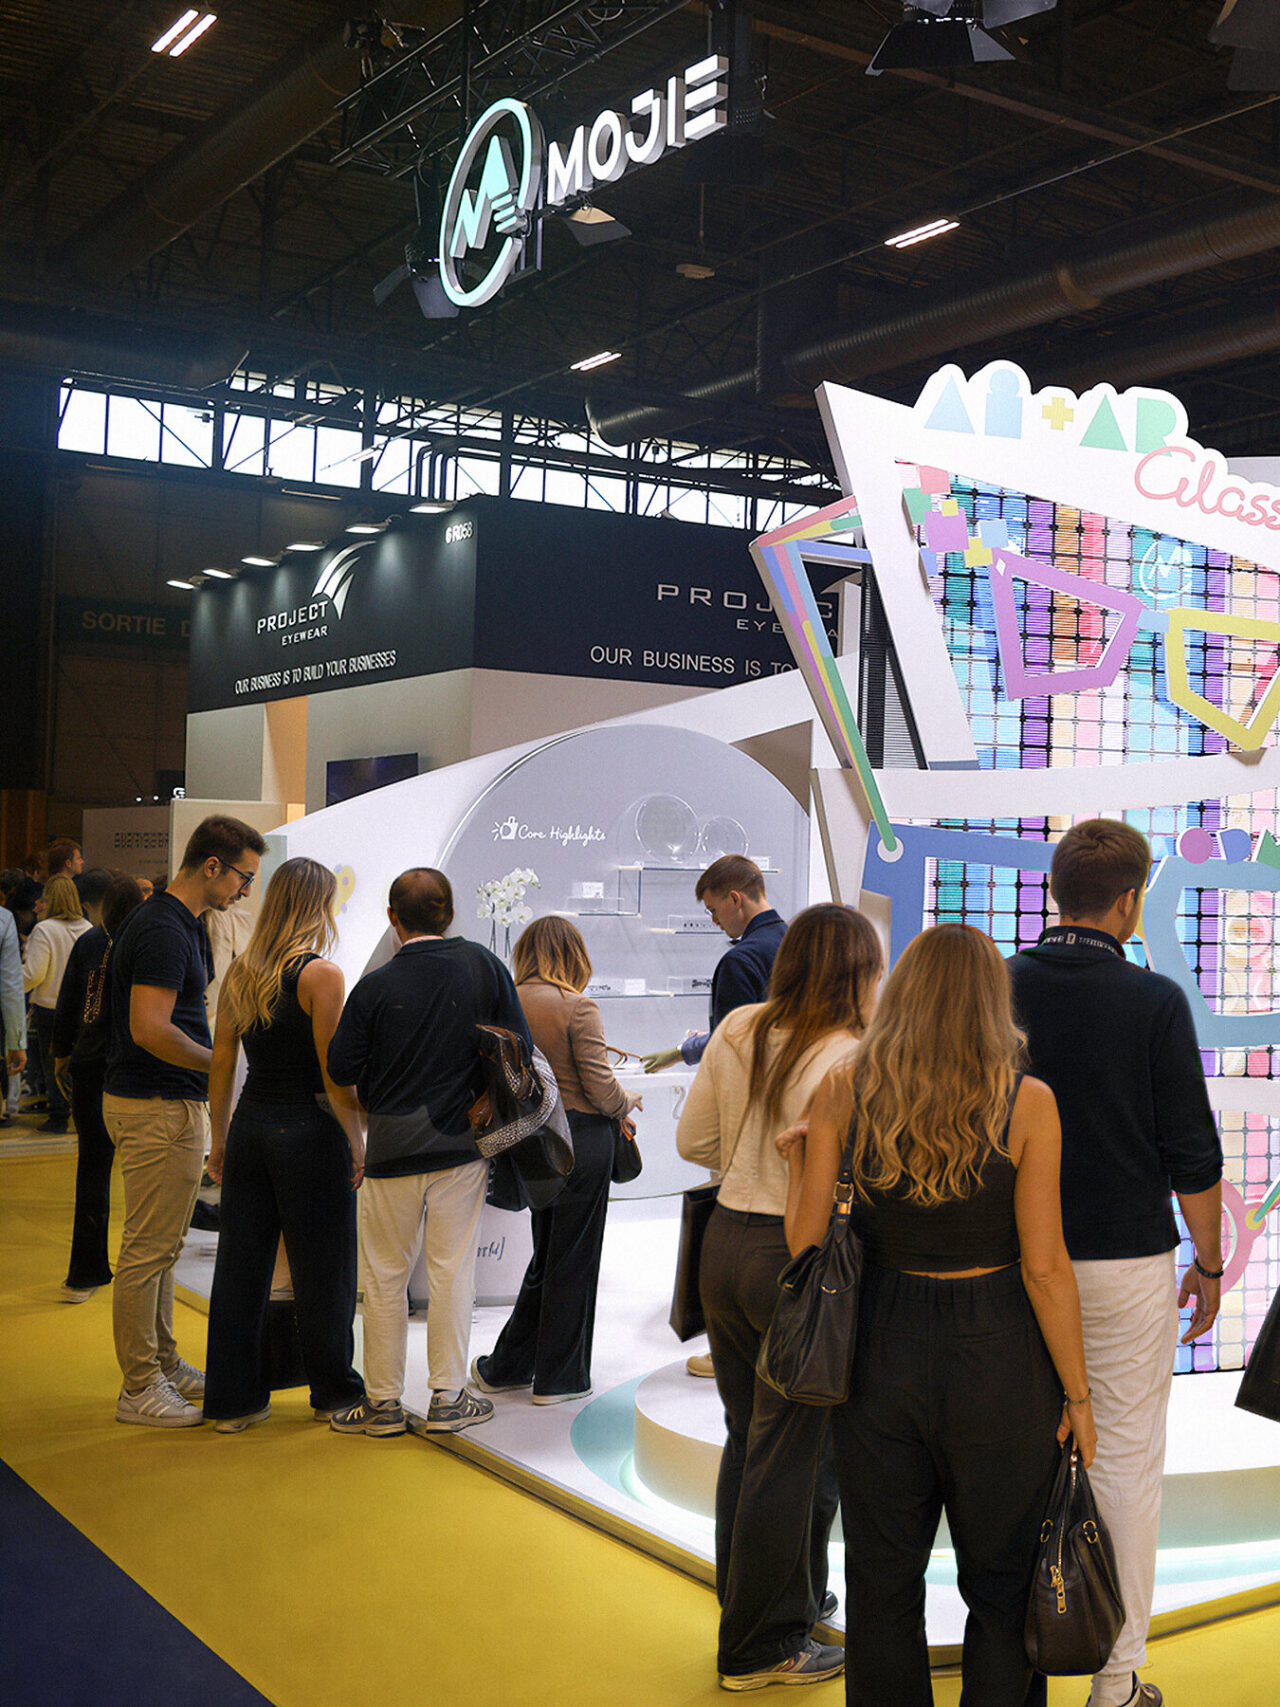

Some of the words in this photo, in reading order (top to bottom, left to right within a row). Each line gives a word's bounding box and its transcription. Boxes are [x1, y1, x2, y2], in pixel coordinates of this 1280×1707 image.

[547, 54, 730, 207] MOJIE
[256, 600, 329, 635] PROJECT
[657, 583, 833, 619] PROJC
[81, 610, 167, 636] SORTIE
[281, 625, 329, 647] EYEWEAR
[234, 676, 249, 694] OUR
[250, 672, 282, 692] BUSINESS
[282, 669, 290, 686] IS
[291, 668, 302, 684] TO
[303, 663, 324, 682] BUILD
[325, 658, 348, 677] YOUR
[348, 650, 397, 673] BUSINESSES
[590, 645, 633, 665] OUR
[643, 650, 735, 675] BUSINESS
[745, 659, 762, 676] IS
[770, 662, 793, 676] TO
[517, 824, 546, 840] Core
[549, 822, 607, 847] Highlights
